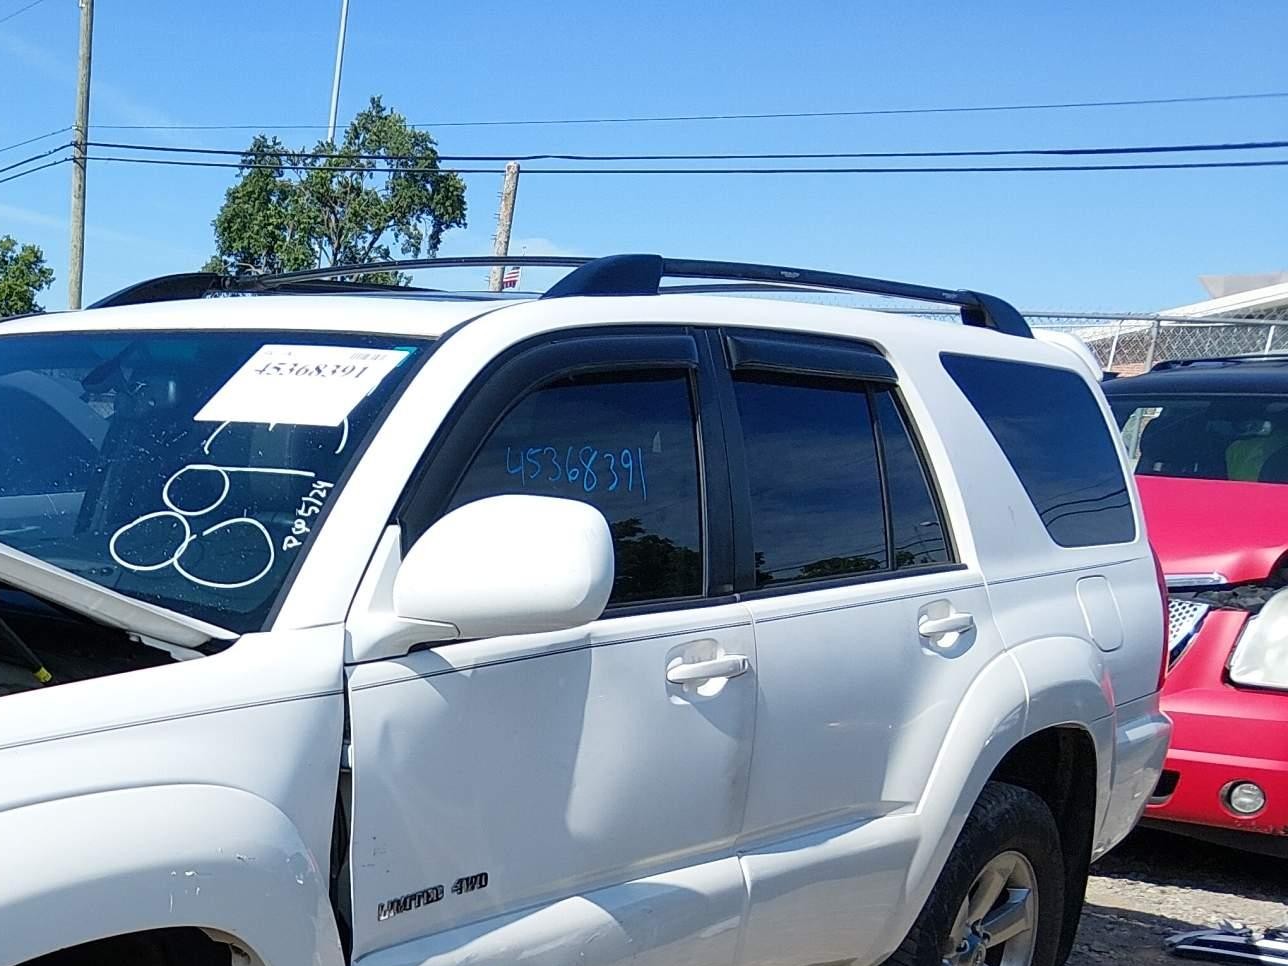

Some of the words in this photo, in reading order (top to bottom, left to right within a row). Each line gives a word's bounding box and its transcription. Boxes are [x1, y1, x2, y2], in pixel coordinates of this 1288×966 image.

[254, 361, 369, 379] 45368391
[506, 445, 648, 501] 45368391
[377, 884, 445, 921] LIMITED
[451, 872, 489, 895] 4WD
